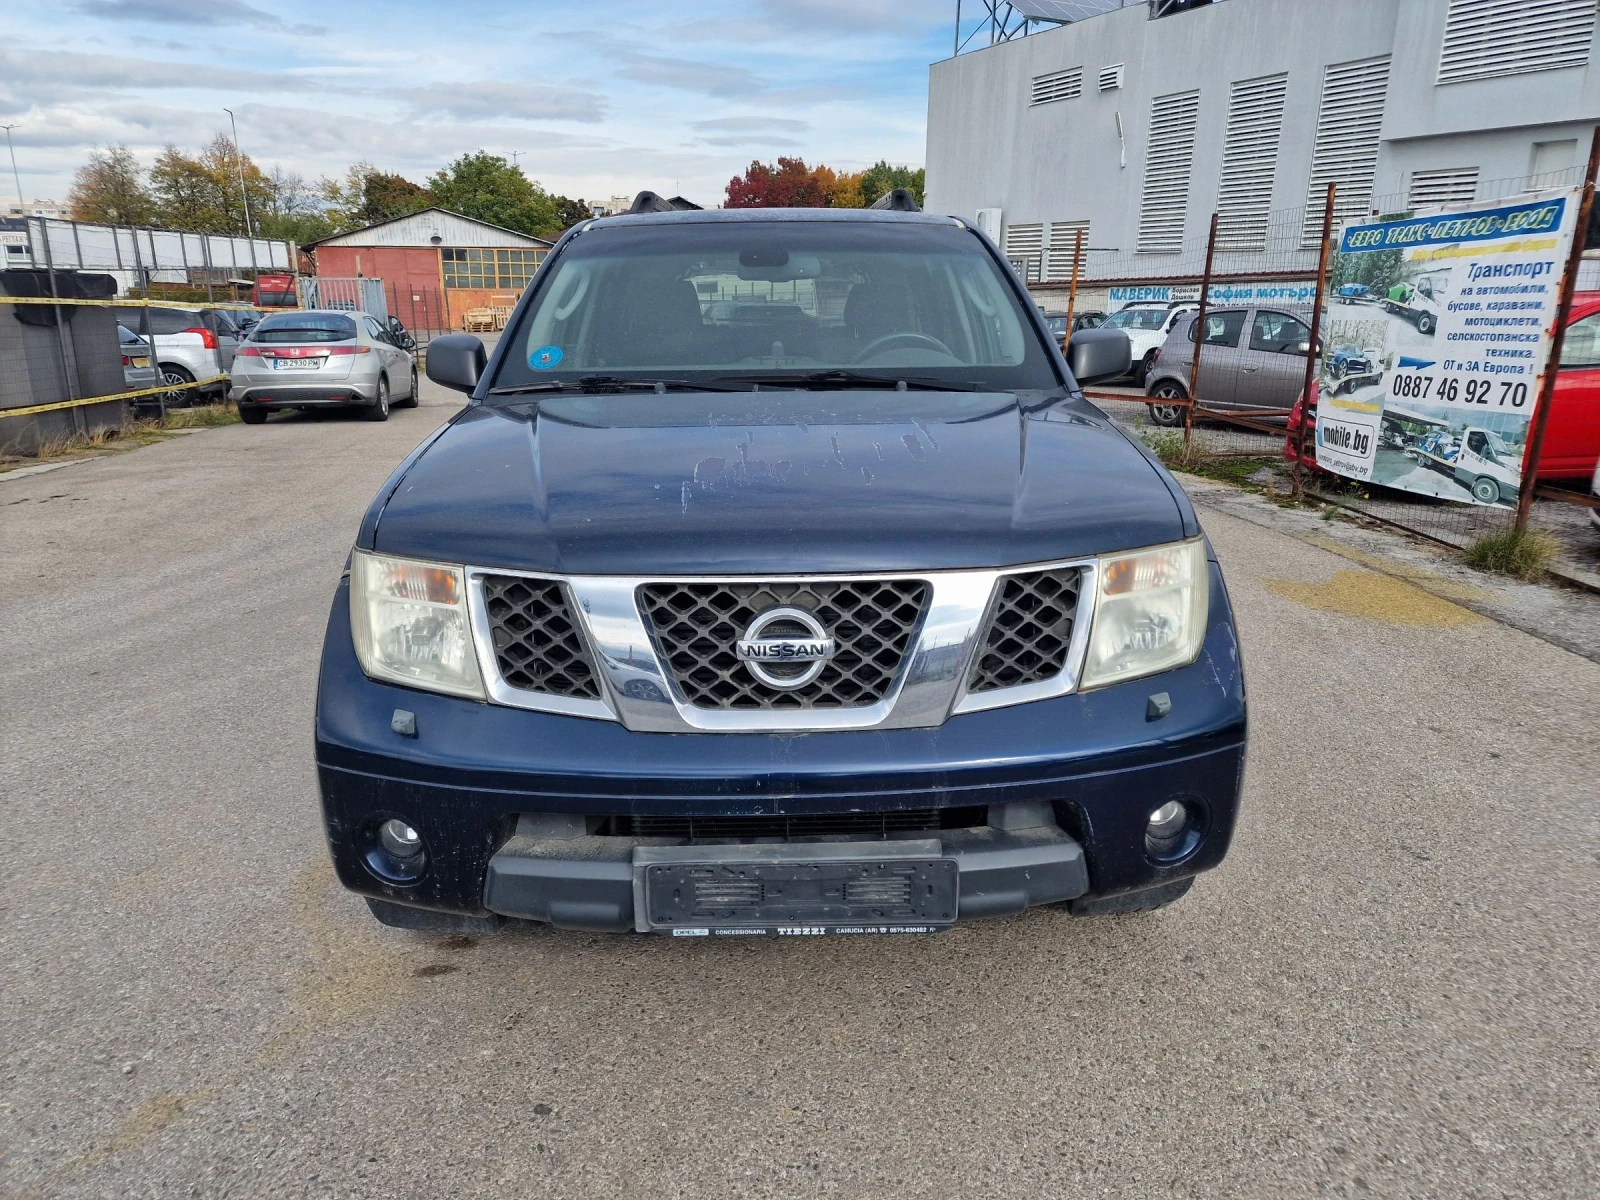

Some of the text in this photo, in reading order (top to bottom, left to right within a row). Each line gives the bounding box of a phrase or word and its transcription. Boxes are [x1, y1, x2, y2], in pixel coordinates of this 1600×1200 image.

[1468, 261, 1555, 282] Транспорт
[1109, 287, 1171, 300] МАВЕРИК
[1172, 286, 1200, 294] Борислав
[1460, 283, 1549, 296] на автомобили,
[1447, 300, 1545, 313] бусове, каравани,
[1465, 317, 1542, 328] мотоциклети,
[1447, 332, 1540, 343] селскостопанска
[1485, 348, 1536, 359] техника.
[1443, 360, 1456, 371] ОТ
[1457, 362, 1463, 371] и
[1465, 361, 1480, 372] ЗА
[1483, 361, 1524, 375] Европа
[1393, 374, 1528, 407] 0887 46 92 70
[1323, 425, 1369, 454] mobile.bg
[747, 643, 824, 657] NISSAN
[777, 927, 826, 936] TIEZZI
[865, 927, 878, 935] (AR)
